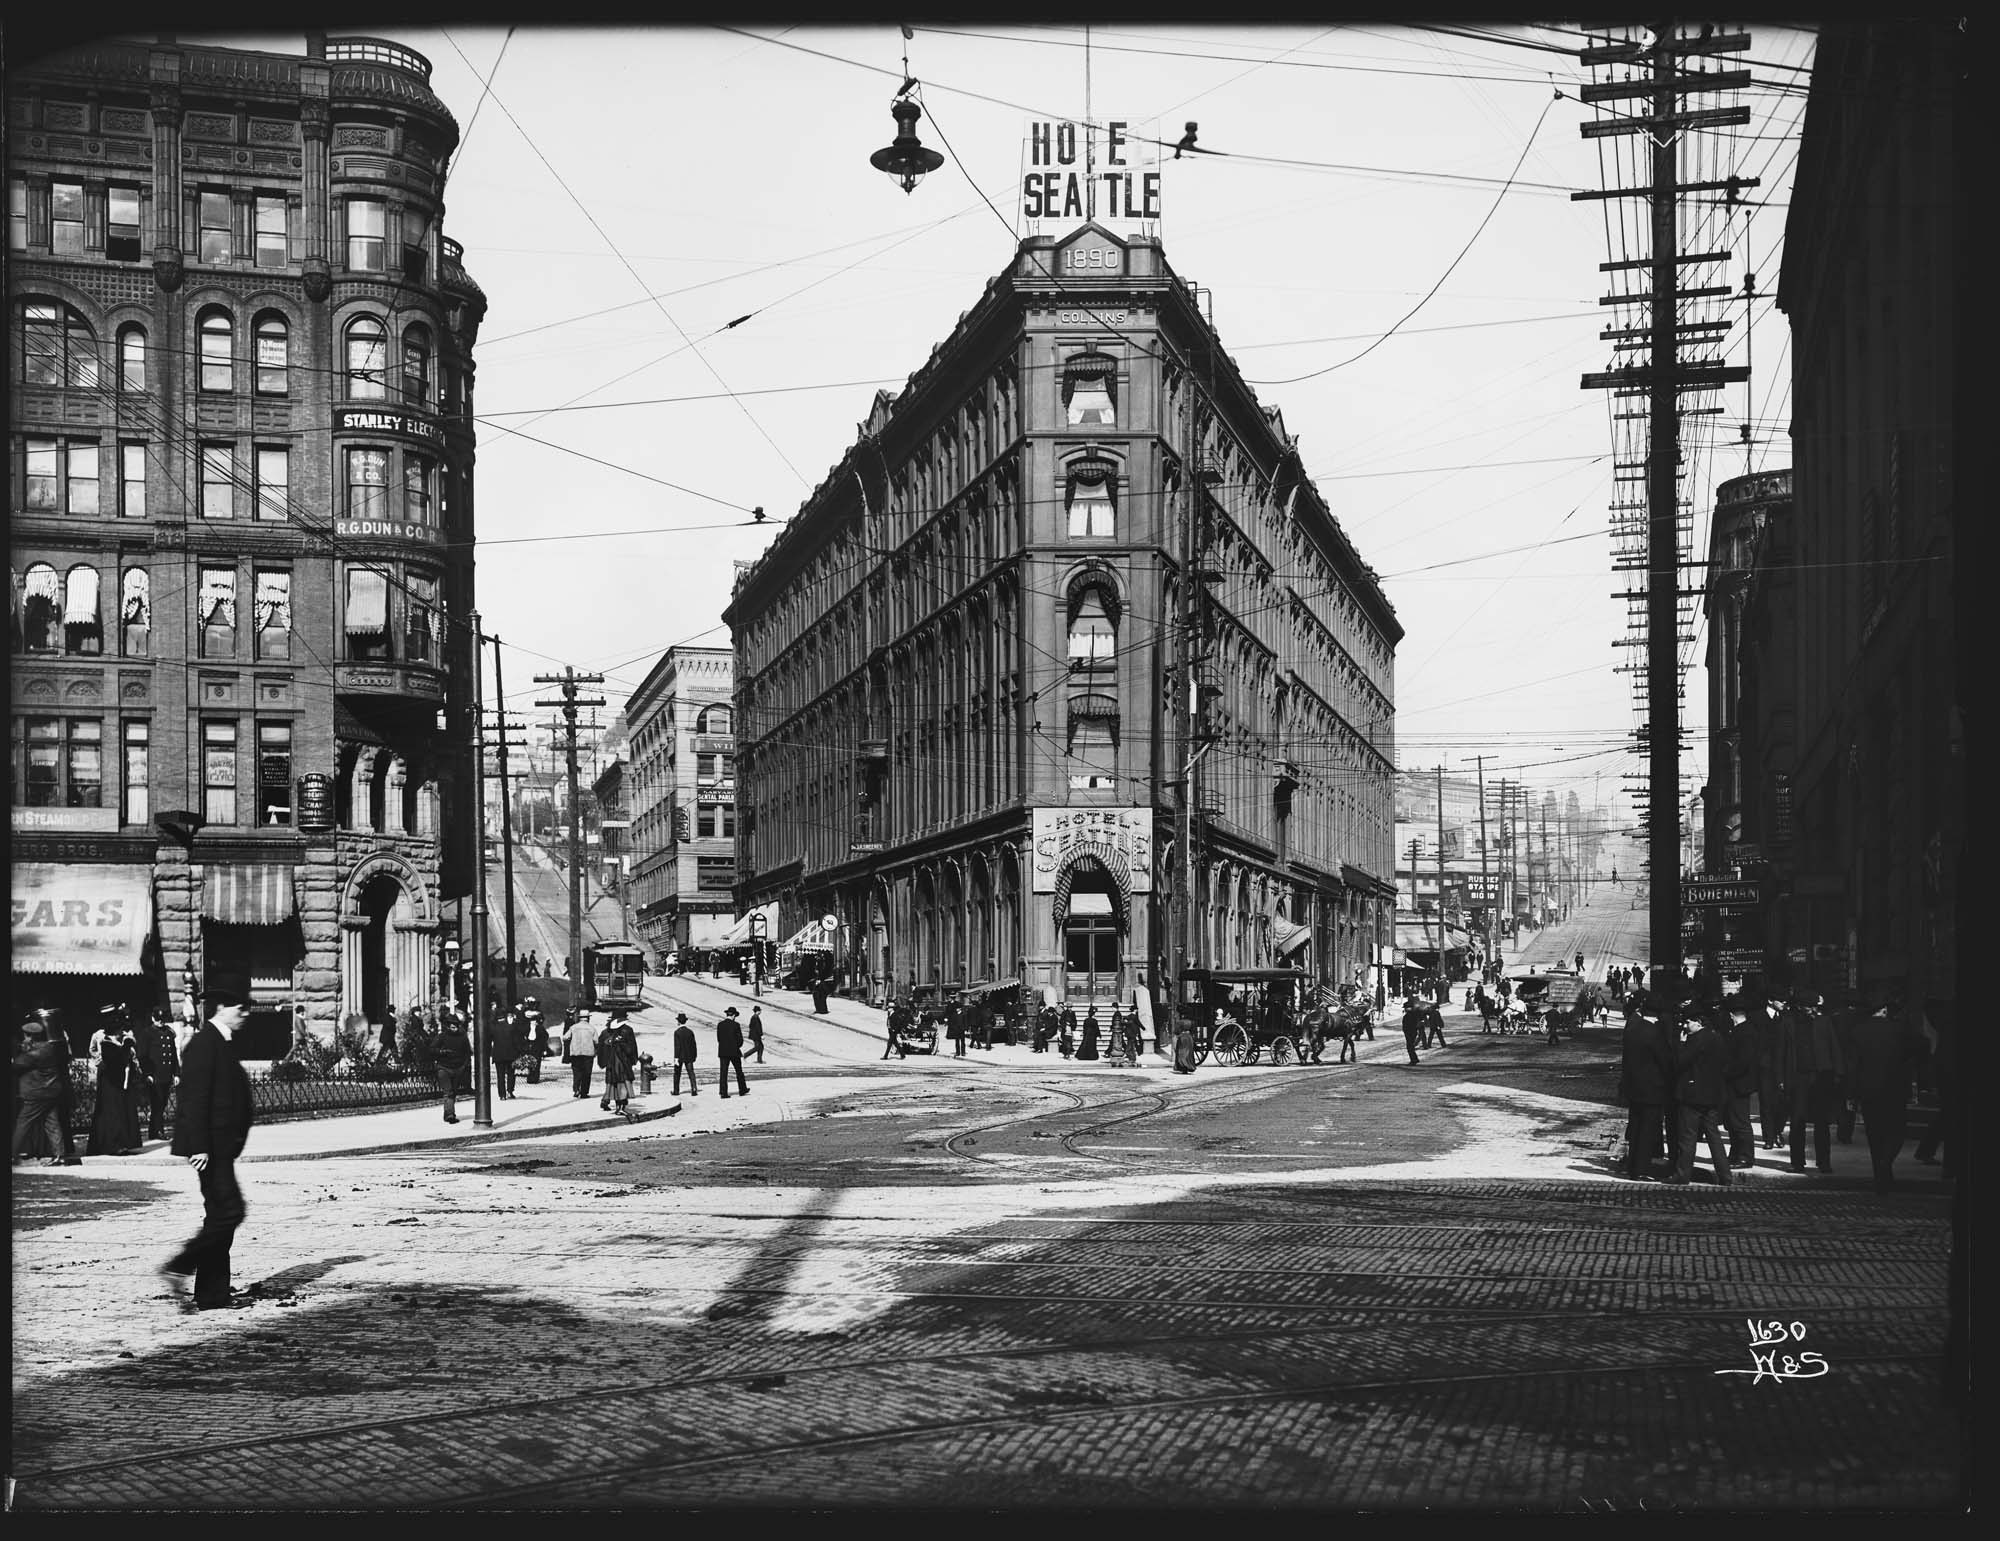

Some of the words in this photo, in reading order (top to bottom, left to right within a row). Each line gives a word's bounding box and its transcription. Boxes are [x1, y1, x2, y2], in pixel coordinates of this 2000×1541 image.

[1065, 249, 1118, 269] 1890
[1061, 312, 1126, 324] COLLINS
[343, 413, 402, 430] STANLEY
[337, 521, 392, 535] R.G.DUN
[1056, 809, 1130, 830] HOTEL
[1036, 826, 1149, 873] SEATTLE
[1688, 888, 1756, 903] BOHEMIAN
